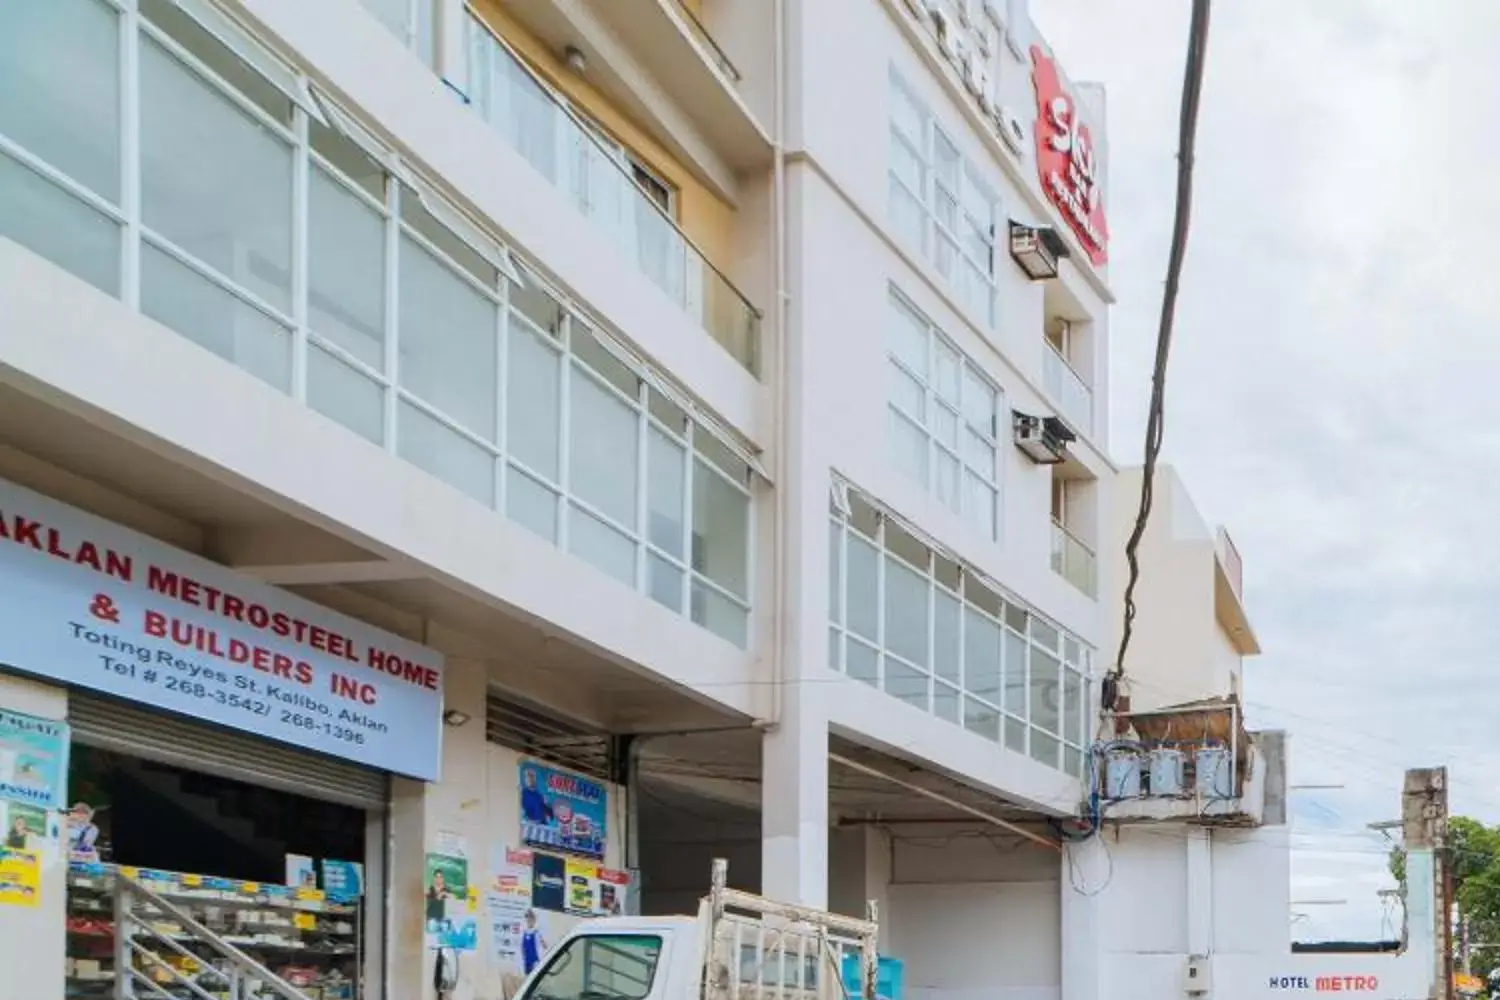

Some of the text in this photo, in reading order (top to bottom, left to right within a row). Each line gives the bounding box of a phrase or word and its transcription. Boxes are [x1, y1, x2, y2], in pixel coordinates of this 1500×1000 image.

[68, 620, 389, 735] Toting Reyes St. Kalibo, Aklan
[89, 592, 377, 706] & BUILDERS INC
[99, 654, 136, 680] Tel
[143, 669, 158, 684] #
[147, 566, 360, 662] METROSTEEL
[368, 647, 440, 690] HOME
[1269, 976, 1378, 991] HOTEL METRO
